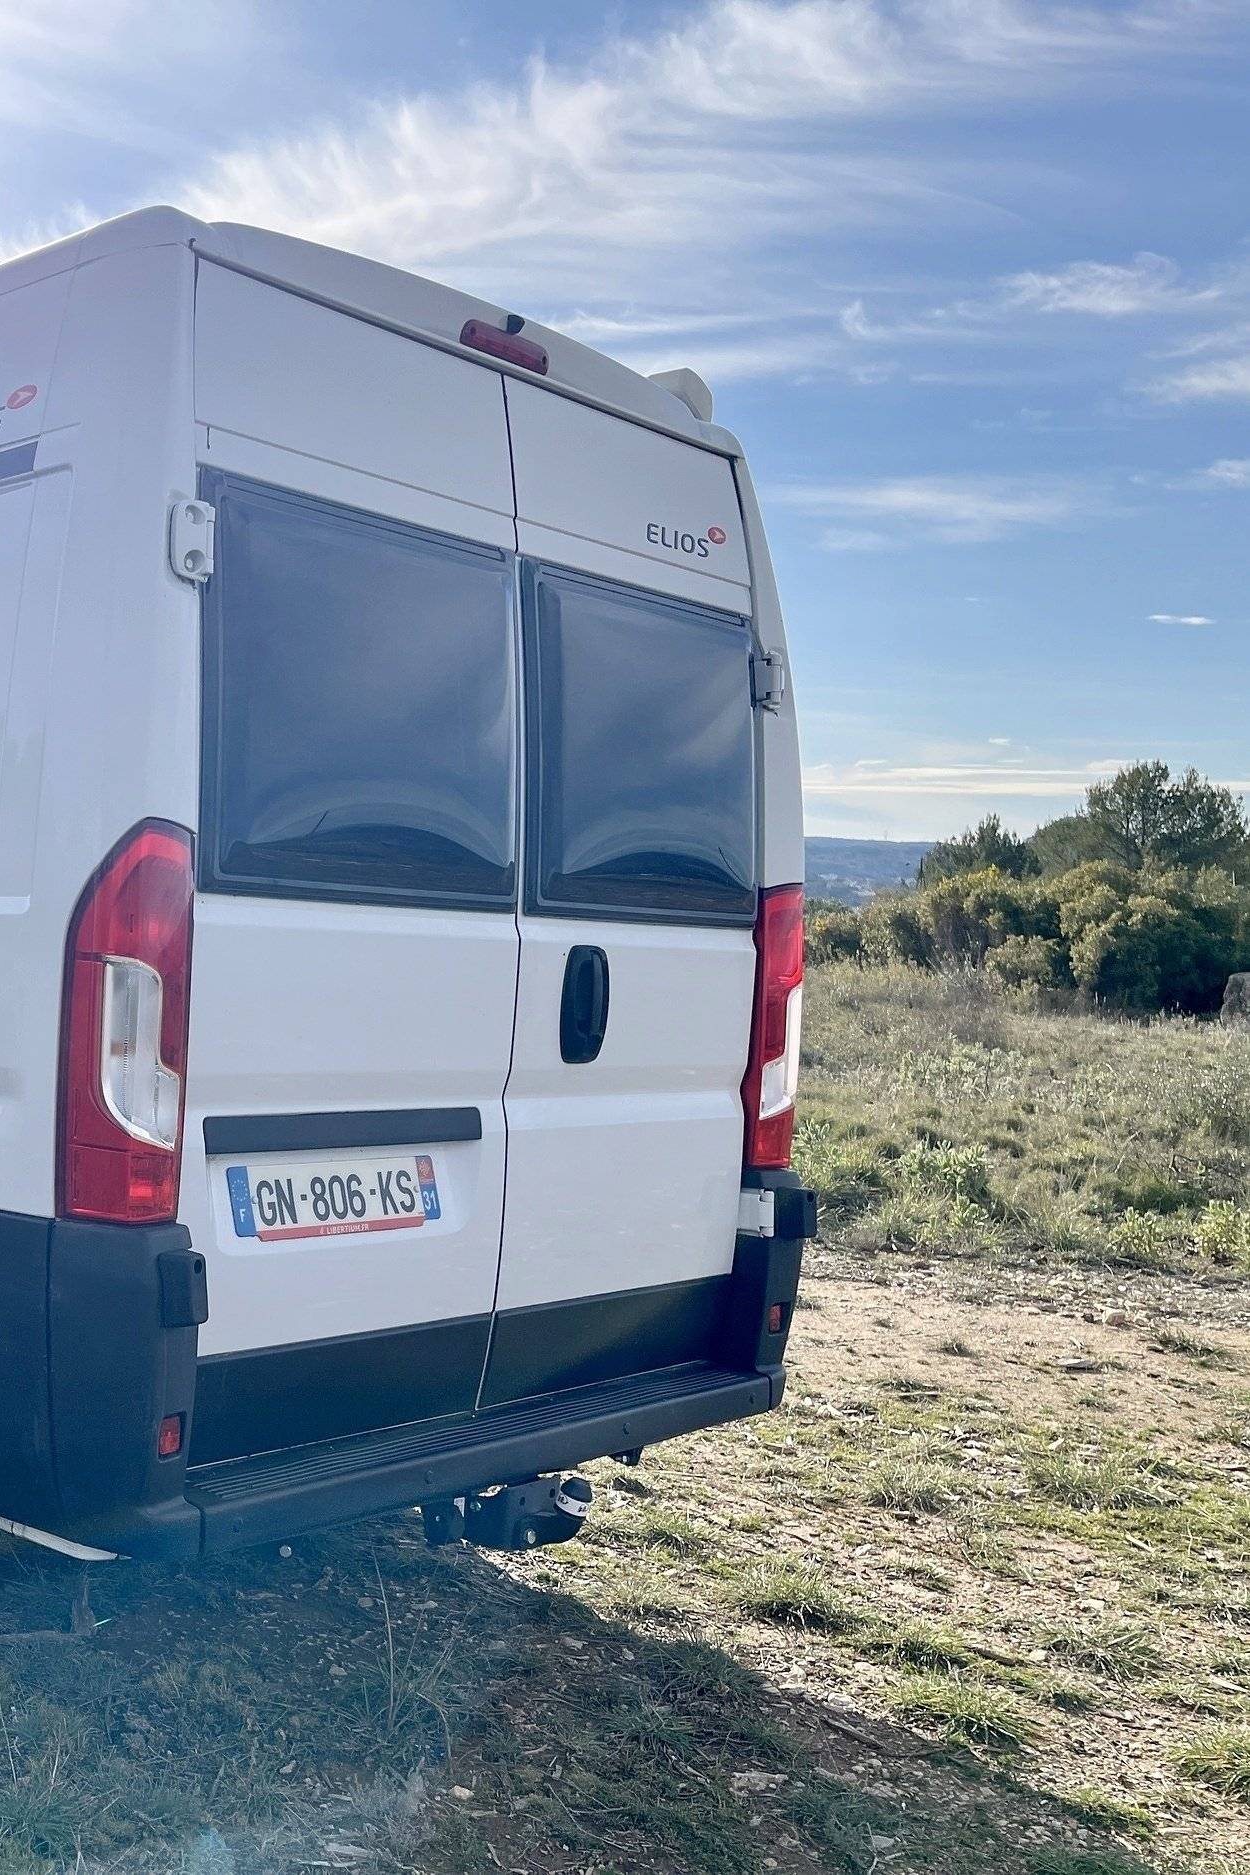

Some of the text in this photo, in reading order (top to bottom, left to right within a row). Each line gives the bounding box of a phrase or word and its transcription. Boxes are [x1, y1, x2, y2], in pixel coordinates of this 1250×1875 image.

[646, 522, 709, 558] ELIOS
[256, 1169, 416, 1227] GN-806-KS
[422, 1190, 437, 1211] 31
[240, 1208, 246, 1223] F
